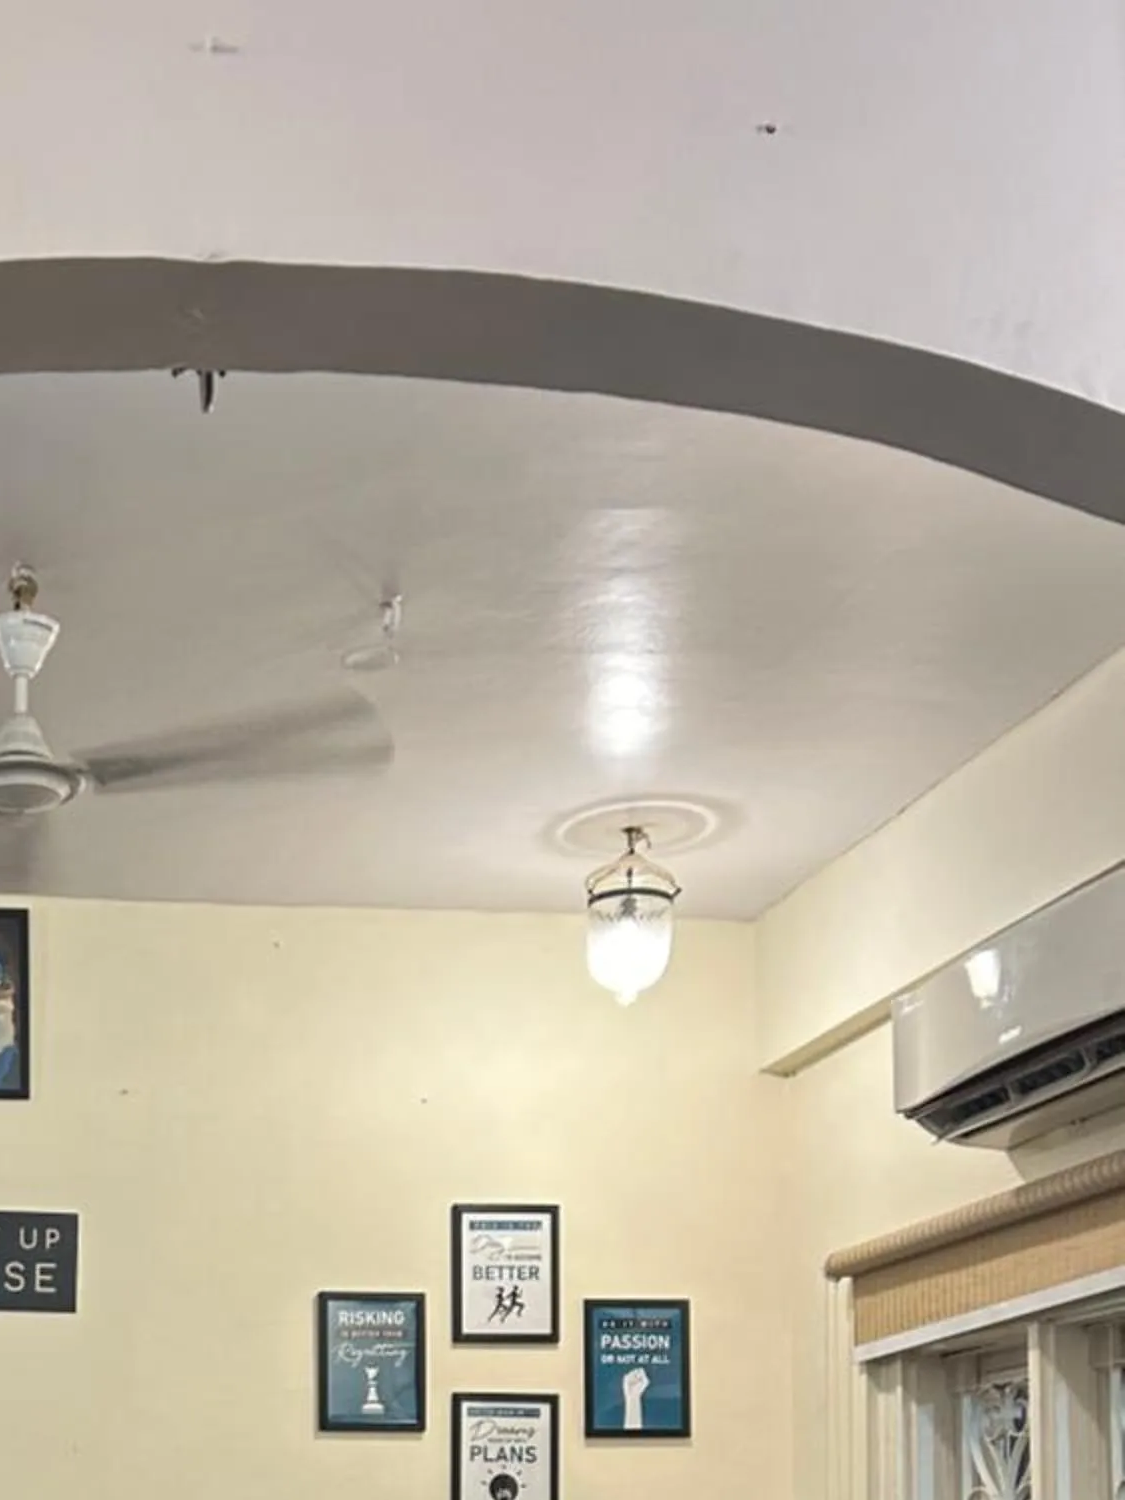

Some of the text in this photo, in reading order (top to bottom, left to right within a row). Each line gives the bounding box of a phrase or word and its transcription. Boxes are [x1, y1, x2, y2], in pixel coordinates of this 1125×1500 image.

[18, 1226, 61, 1250] UP
[472, 1264, 540, 1281] BETTER
[338, 1309, 405, 1326] RISKING
[601, 1334, 670, 1350] PASSION
[651, 1353, 671, 1364] ALL
[469, 1445, 538, 1464] PLANS
